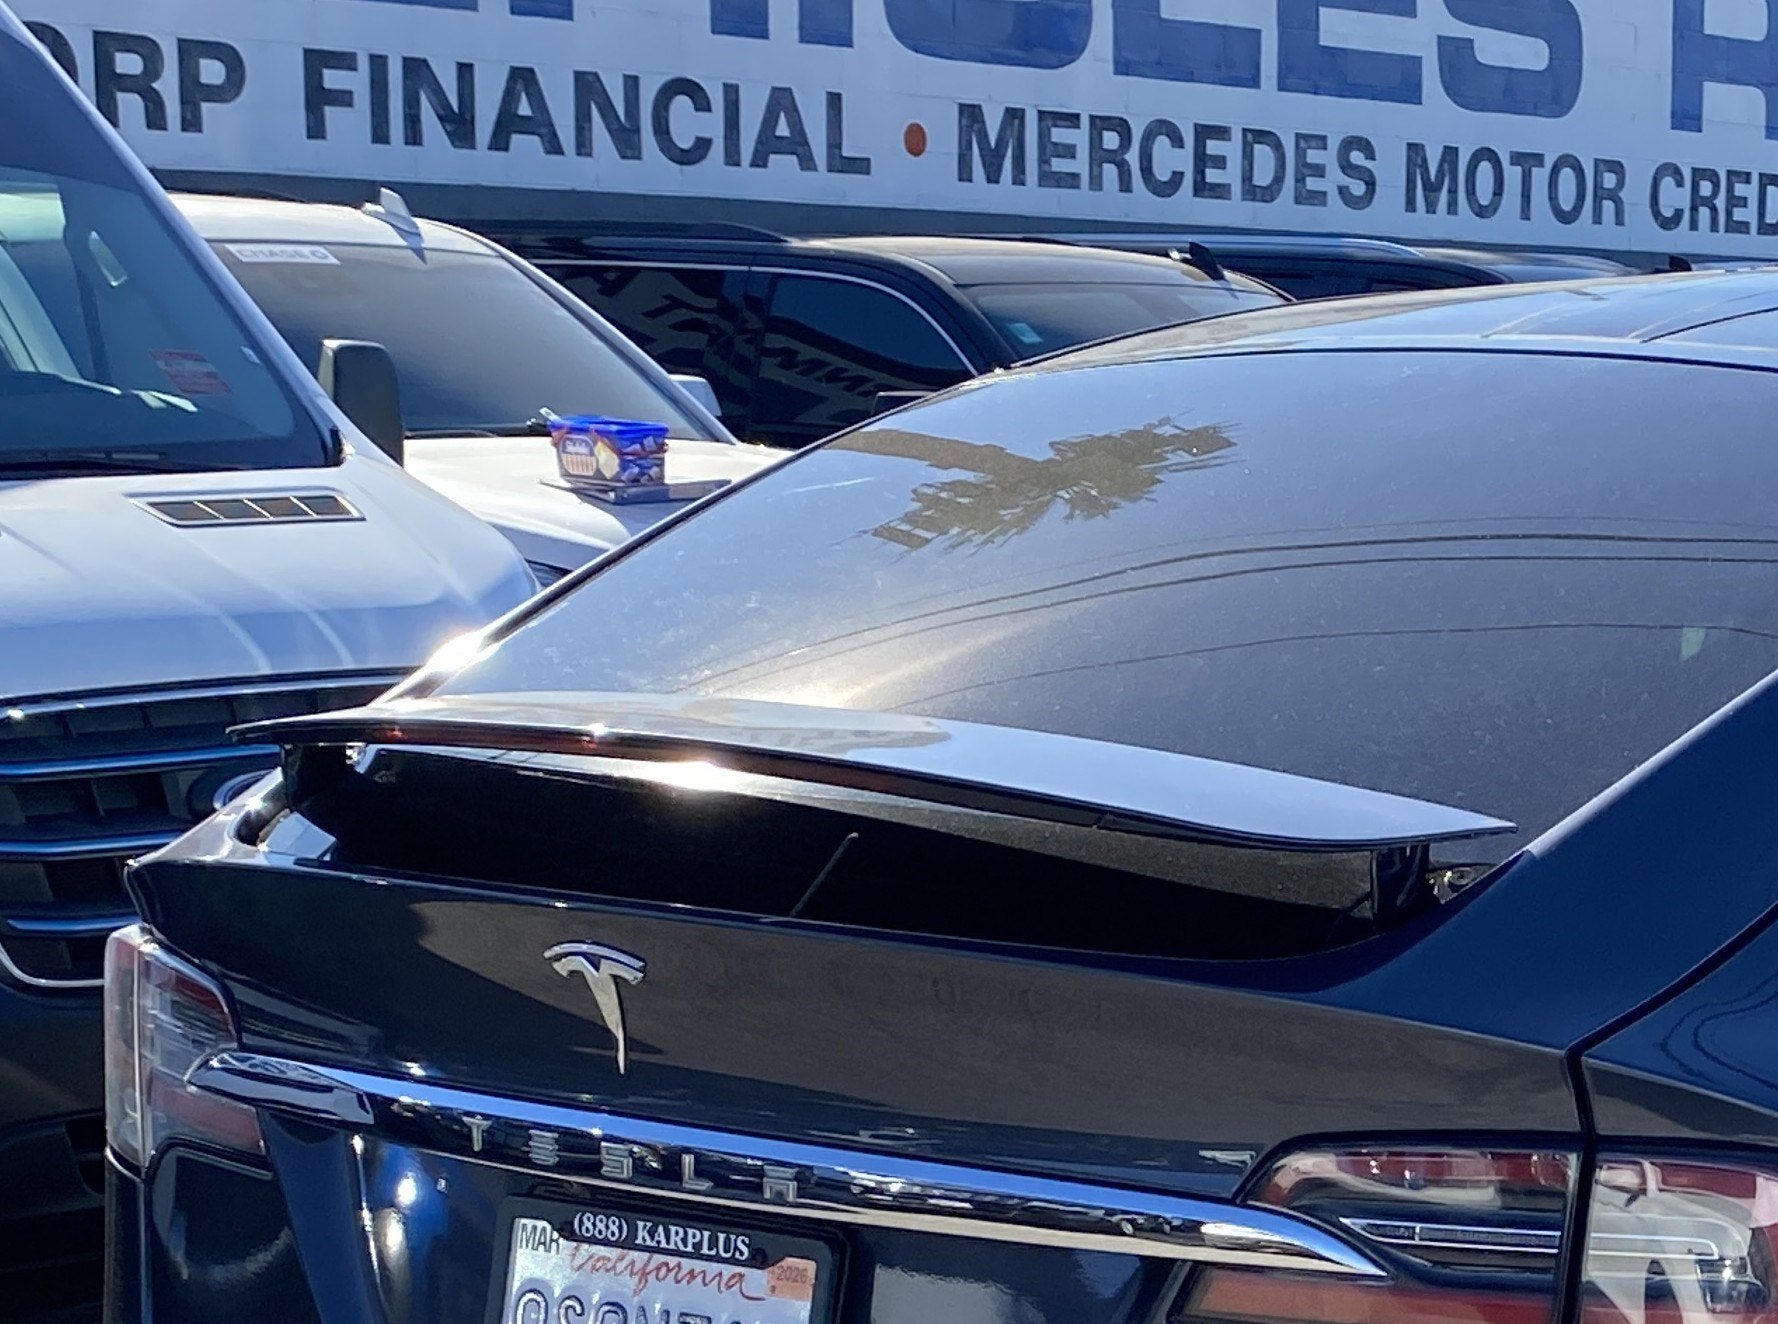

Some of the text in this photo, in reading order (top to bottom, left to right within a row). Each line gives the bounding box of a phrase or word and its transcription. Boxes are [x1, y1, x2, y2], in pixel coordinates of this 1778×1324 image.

[303, 47, 872, 175] FINANCIAL
[957, 103, 1376, 211] MERCEDES
[1405, 141, 1627, 227] MOTOR
[462, 1115, 799, 1200] TESLA
[519, 1223, 560, 1255] MAR
[573, 1211, 750, 1260] (888) KARPLUS
[569, 1240, 766, 1301] California
